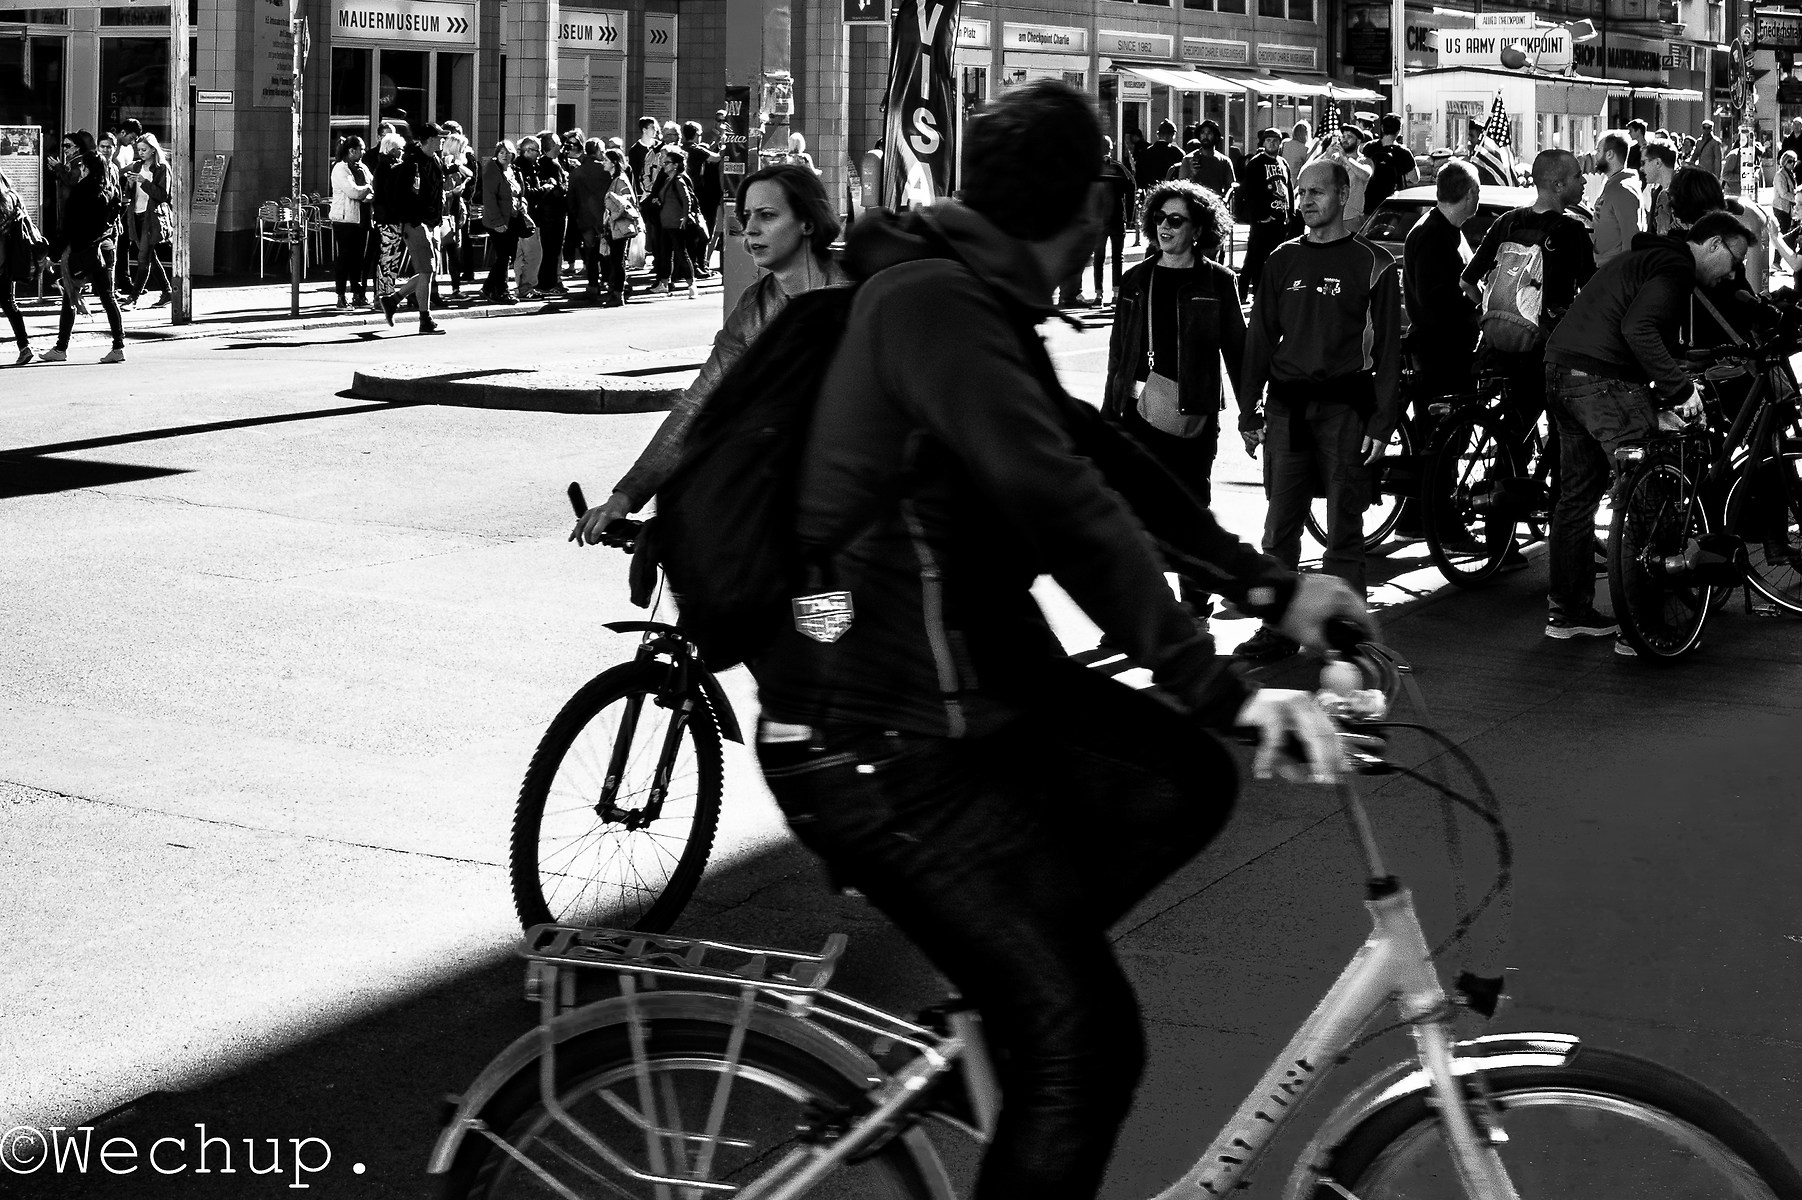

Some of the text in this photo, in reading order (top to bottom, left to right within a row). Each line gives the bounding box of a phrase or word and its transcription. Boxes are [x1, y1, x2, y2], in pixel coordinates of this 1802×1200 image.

[338, 9, 440, 32] MAUERMUSEUM
[963, 26, 976, 39] Platz
[1018, 31, 1069, 45] am Checkpoint Charlie
[1117, 39, 1152, 52] SINCE 1962
[1445, 38, 1461, 54] US
[1466, 38, 1495, 54] ARMY
